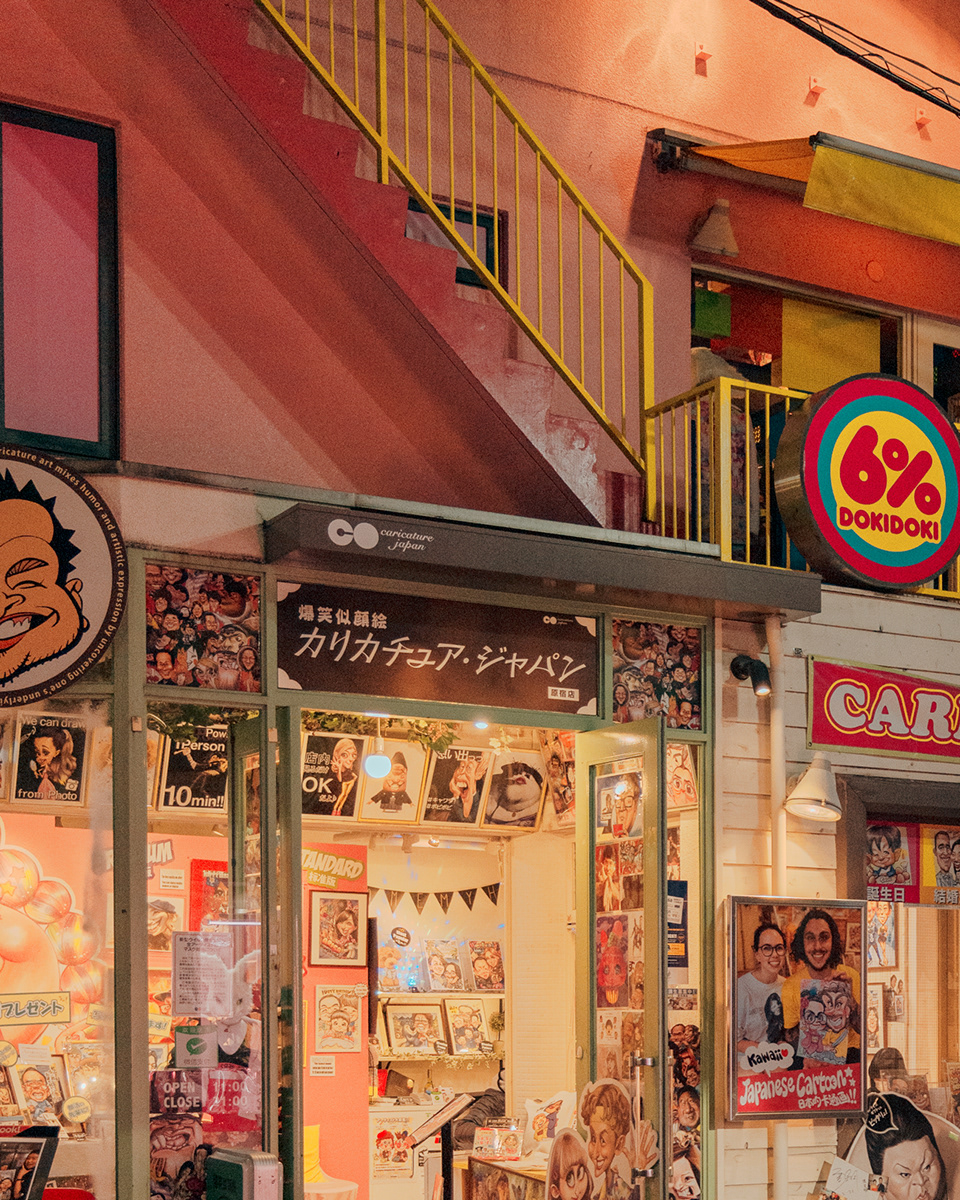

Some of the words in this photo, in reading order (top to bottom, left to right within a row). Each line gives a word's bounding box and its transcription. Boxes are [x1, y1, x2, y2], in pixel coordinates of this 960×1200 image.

[39, 457, 54, 468] art
[839, 425, 942, 516] 6%
[54, 465, 80, 486] mixes
[79, 483, 104, 512] humor
[101, 513, 116, 531] and
[839, 507, 941, 541] DOKIDOKI
[380, 528, 435, 543] caricature
[110, 532, 126, 567] artistic
[387, 538, 427, 553] japan
[110, 571, 126, 623] expression
[298, 604, 388, 630] 爆笑似顔絵
[104, 625, 117, 637] by
[67, 637, 108, 681] uncovering
[294, 627, 587, 684] カリカチュア・ジャパン
[40, 717, 59, 727] can
[18, 788, 44, 799] from
[48, 790, 78, 801] Photo
[302, 776, 334, 794] OK
[164, 786, 192, 807] 10
[867, 886, 906, 902] 誕生日
[163, 1081, 196, 1094] OPEN
[740, 1077, 796, 1107] Japanese
[796, 1069, 848, 1098] Cartoon
[163, 1096, 200, 1108] CLOSE
